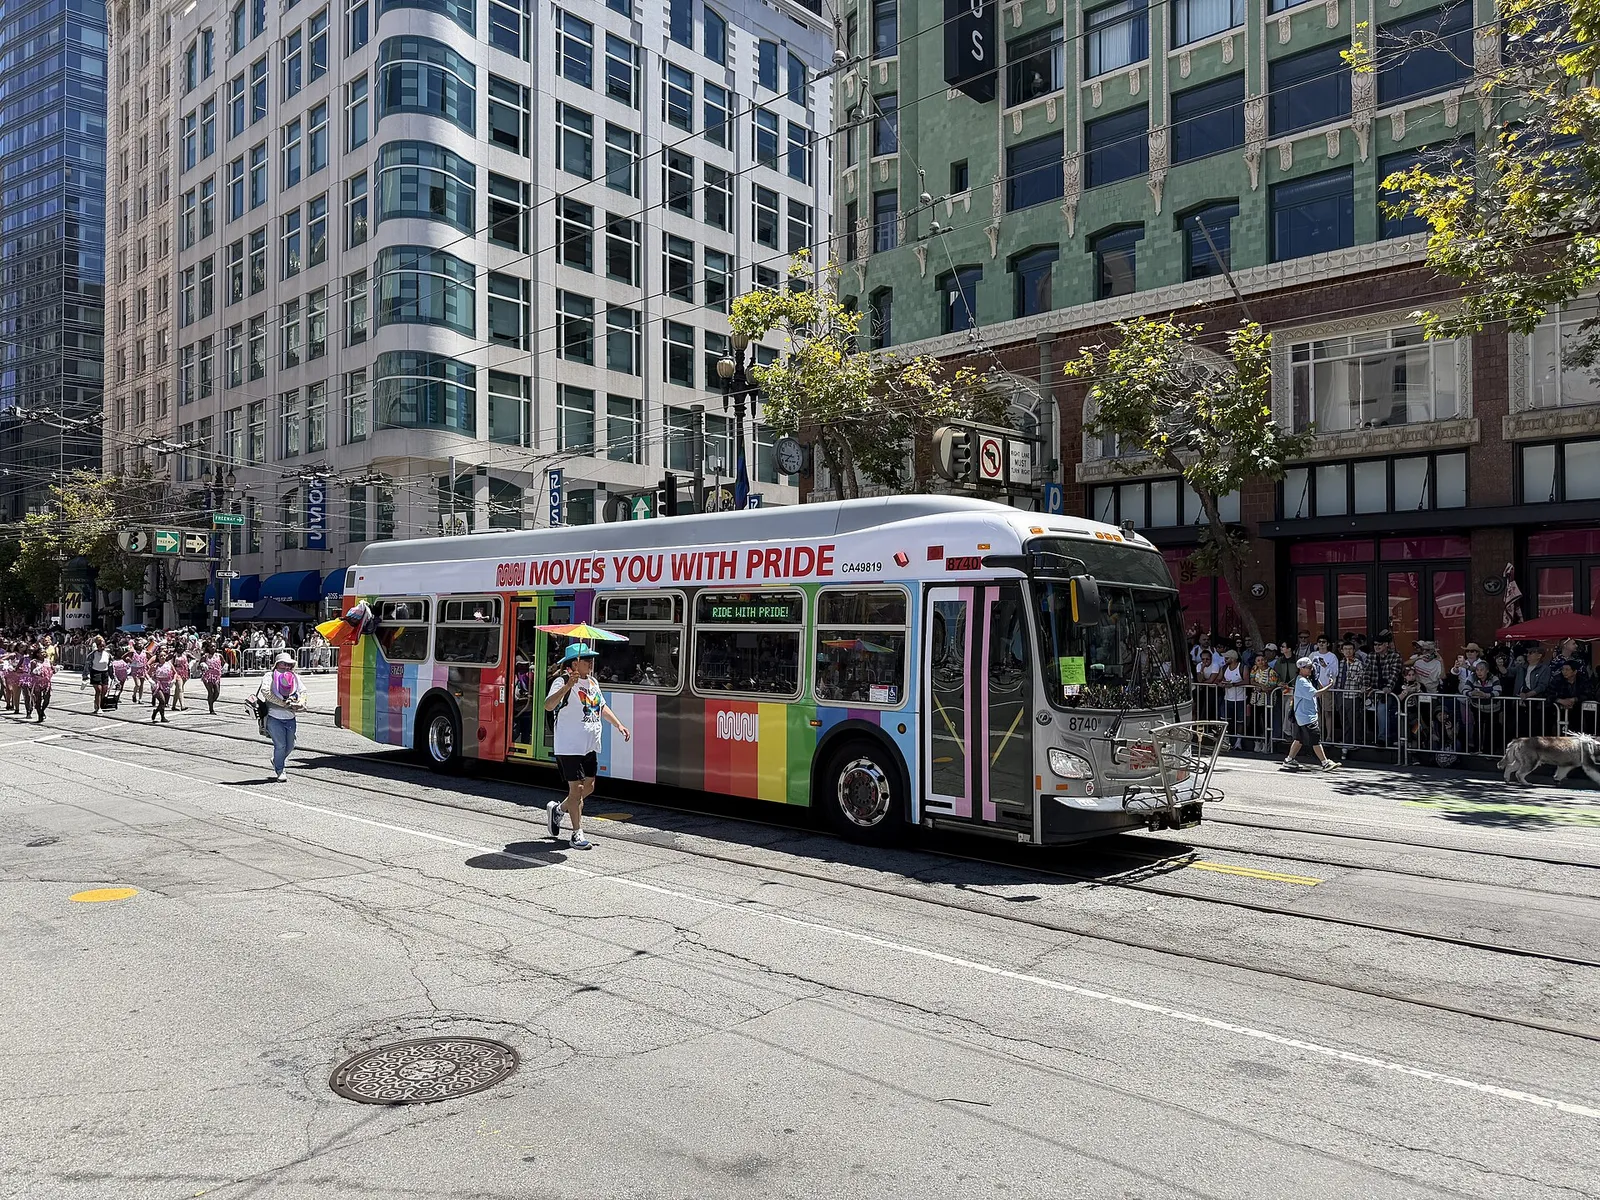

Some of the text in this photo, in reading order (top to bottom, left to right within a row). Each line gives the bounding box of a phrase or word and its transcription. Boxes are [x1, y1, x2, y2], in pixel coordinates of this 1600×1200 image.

[1015, 459, 1027, 467] MUST
[550, 474, 561, 527] ROS
[529, 557, 606, 586] MOVES
[612, 554, 664, 583] YOU
[670, 550, 738, 581] WITH
[745, 544, 836, 579] PRIDE
[841, 561, 882, 573] CA49819
[947, 557, 979, 571] 8740
[712, 606, 789, 618] RIDE WITH PRIDE!
[1069, 717, 1098, 731] 8740
